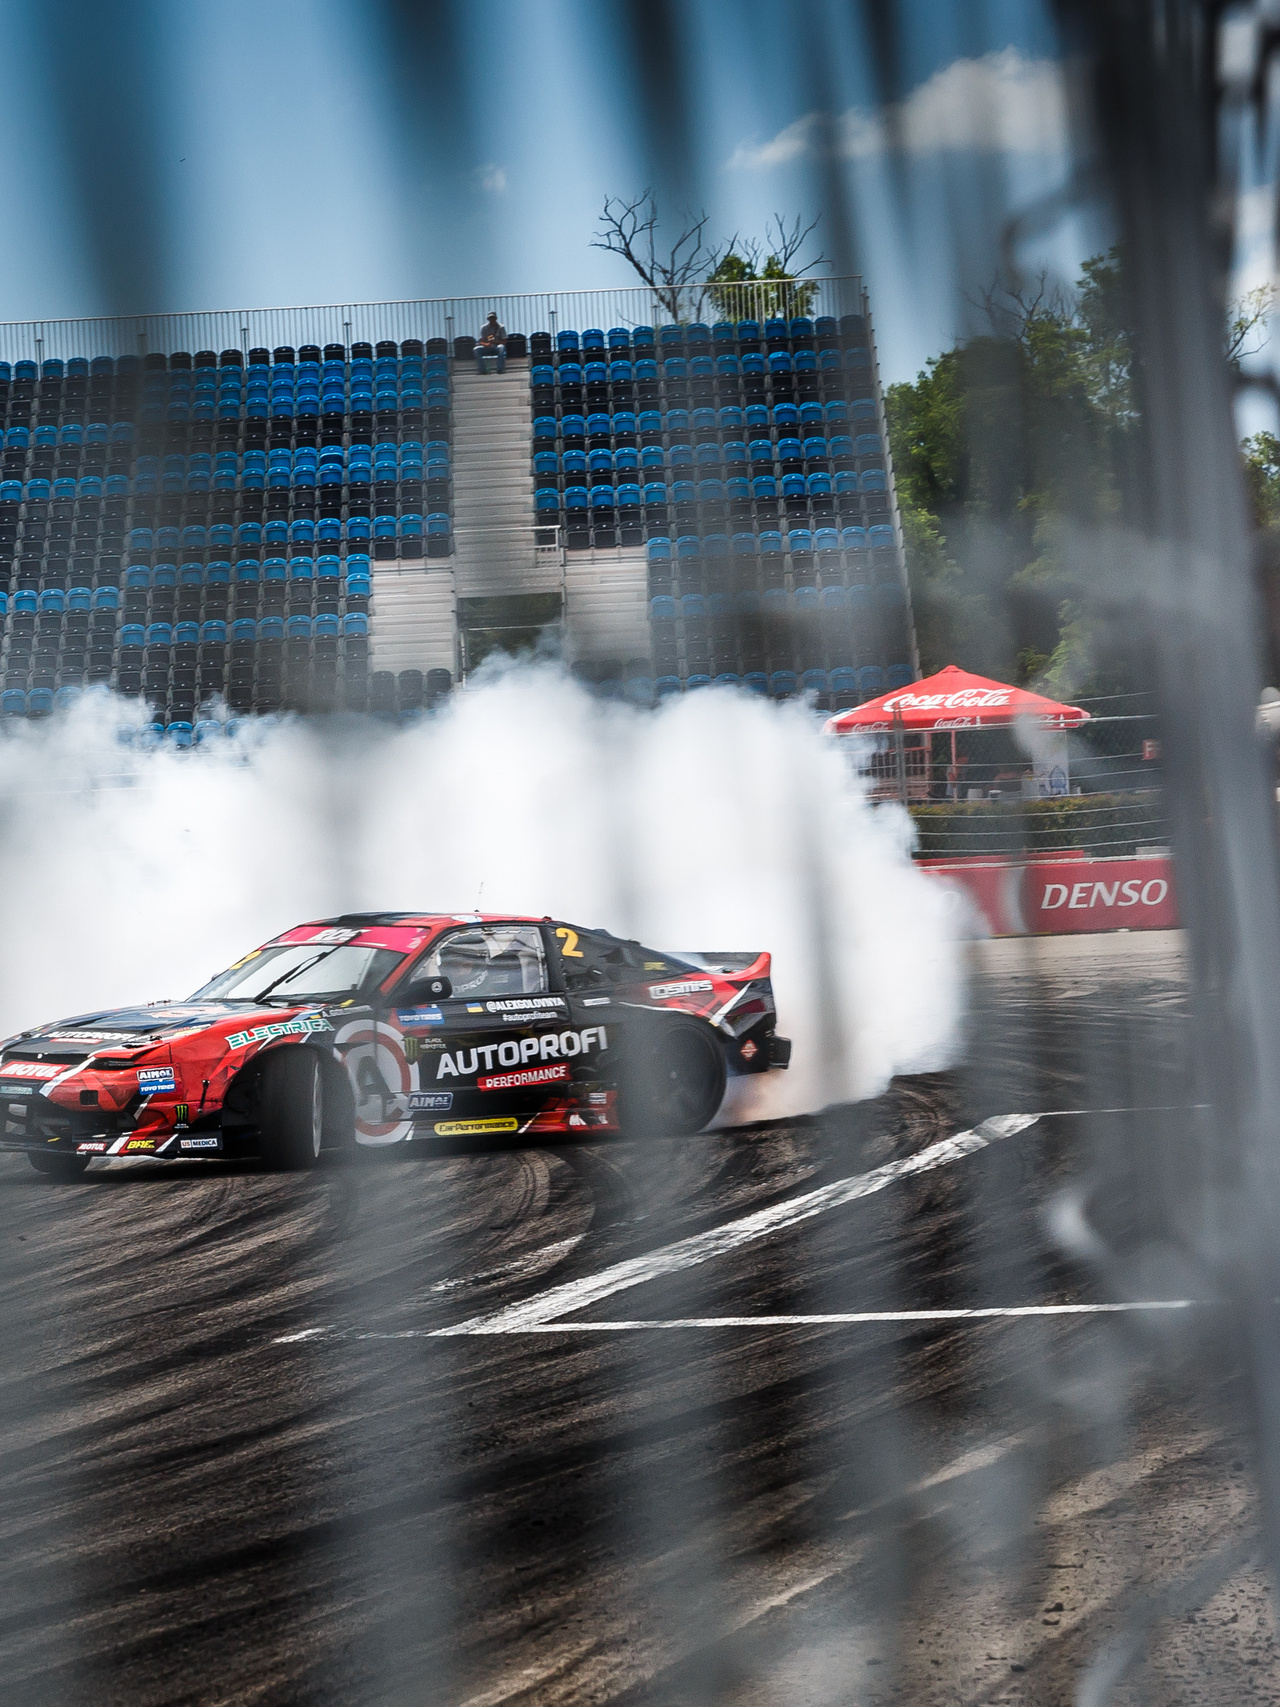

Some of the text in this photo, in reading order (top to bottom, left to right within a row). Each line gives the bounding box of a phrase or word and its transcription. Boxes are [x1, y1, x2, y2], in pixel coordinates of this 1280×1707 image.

[882, 688, 1016, 712] Coca-Cola
[1040, 879, 1168, 909] DENSO
[556, 927, 584, 958] 2
[227, 1019, 334, 1049] ELECTRICA
[436, 1026, 608, 1079] AUTOPROFI
[0, 1063, 62, 1078] MOTUL
[485, 1065, 567, 1088] PERFORMANCE
[140, 1085, 157, 1093] TOYO
[78, 1142, 106, 1150] MOTUL
[192, 1139, 217, 1147] MEDICA
